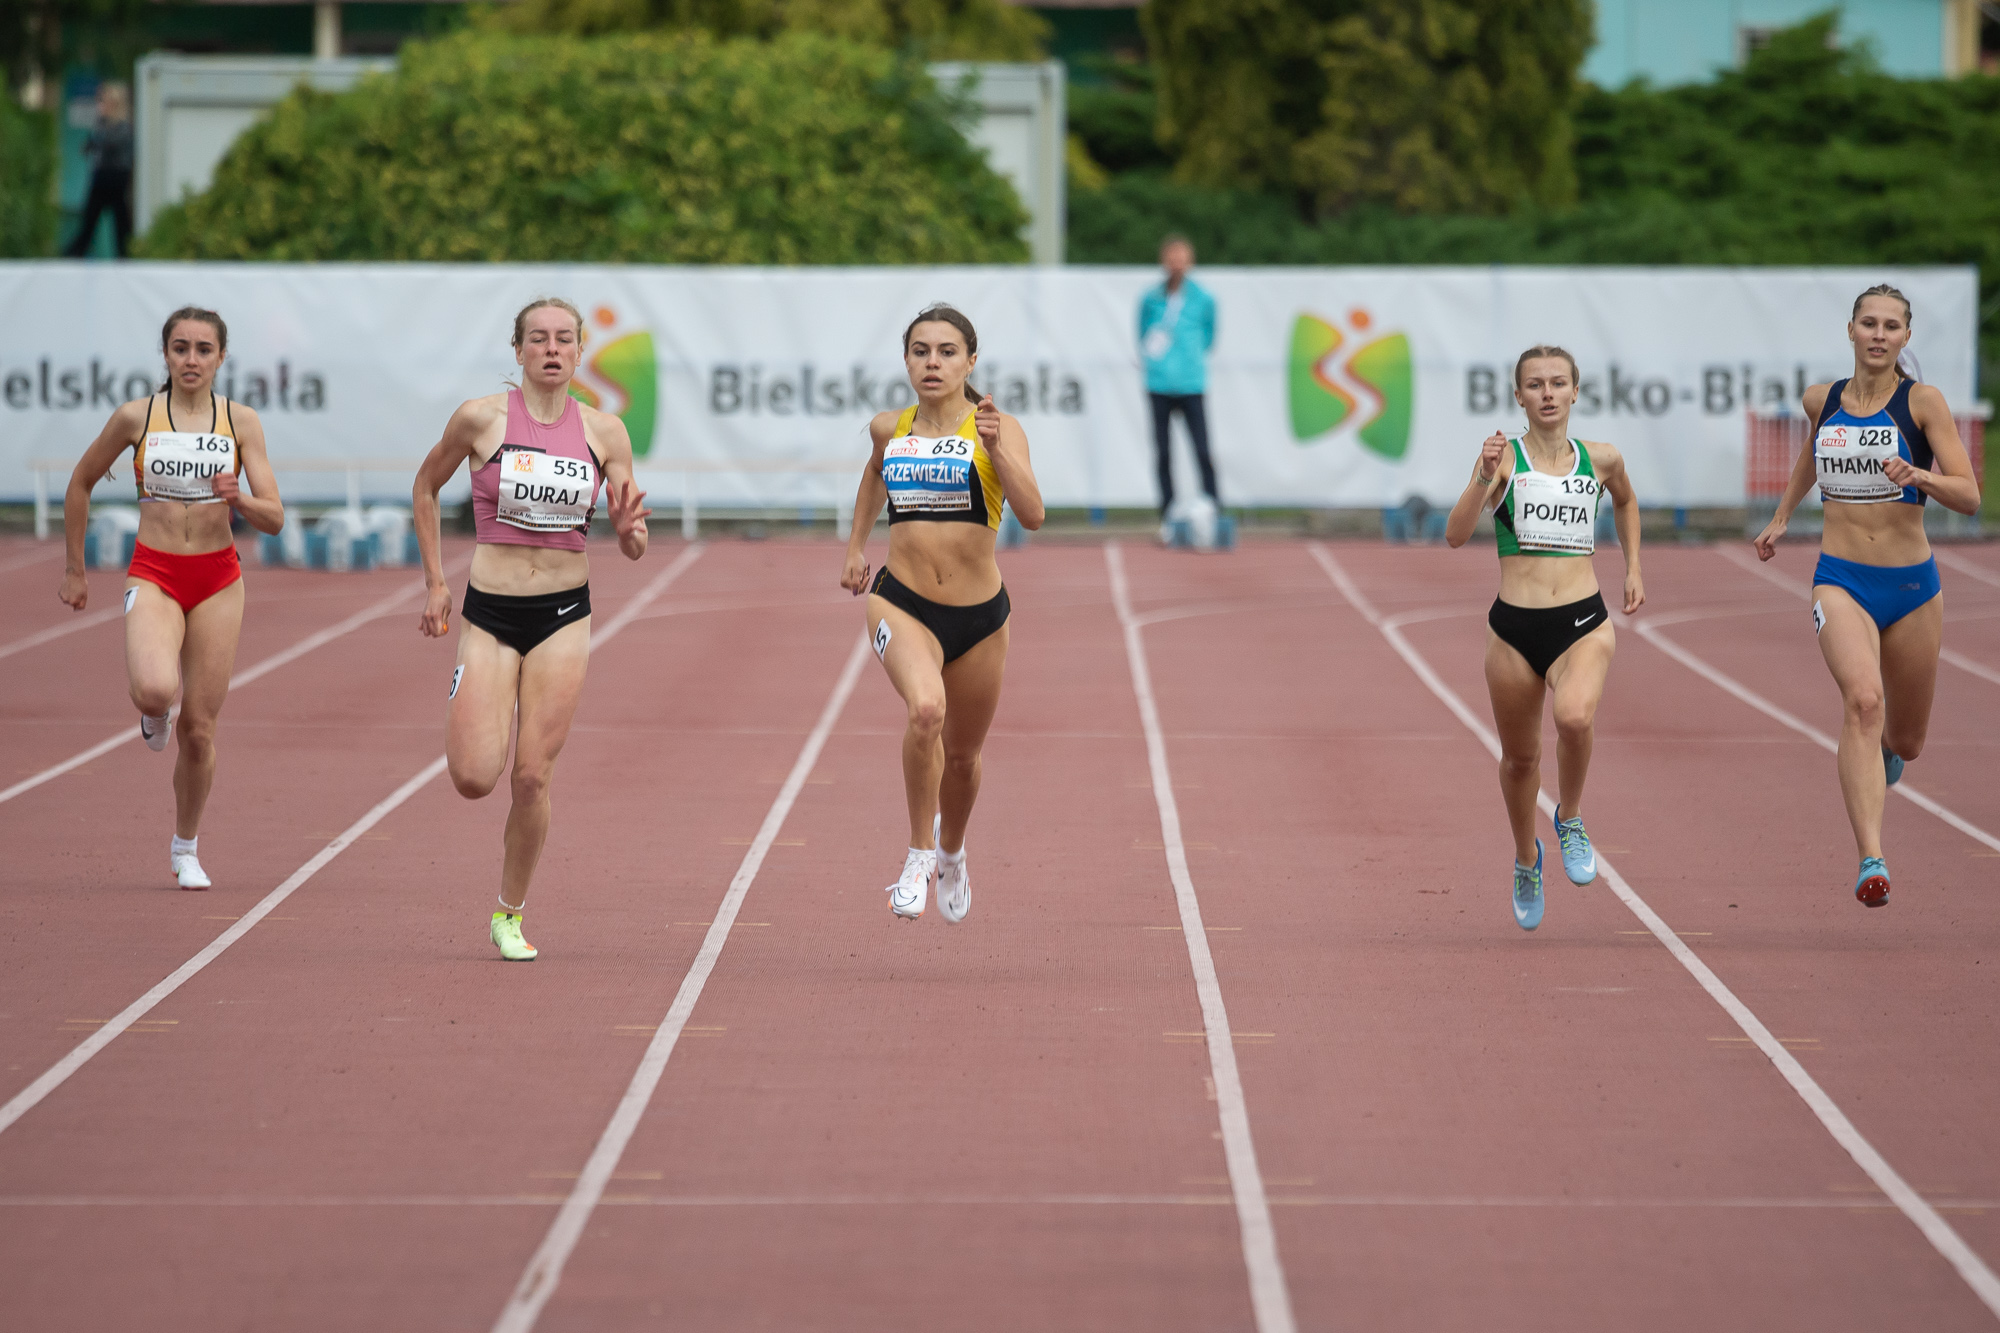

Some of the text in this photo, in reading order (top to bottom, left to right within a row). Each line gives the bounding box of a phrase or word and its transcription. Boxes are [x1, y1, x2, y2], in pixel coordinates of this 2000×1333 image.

[195, 436, 230, 454] 163
[931, 439, 968, 456] 655
[1822, 439, 1846, 447] ORLEN
[1858, 429, 1892, 447] 628
[891, 448, 918, 456] ORLEN
[150, 459, 226, 478] OSIPIUK
[553, 460, 590, 482] 551
[882, 461, 967, 484] PRZEWIEŹLIK
[513, 482, 580, 506] DURAJ
[1561, 478, 1596, 495] 136
[1523, 502, 1588, 526] POJĘTA
[1812, 609, 1821, 635] 3
[876, 626, 887, 655] 5
